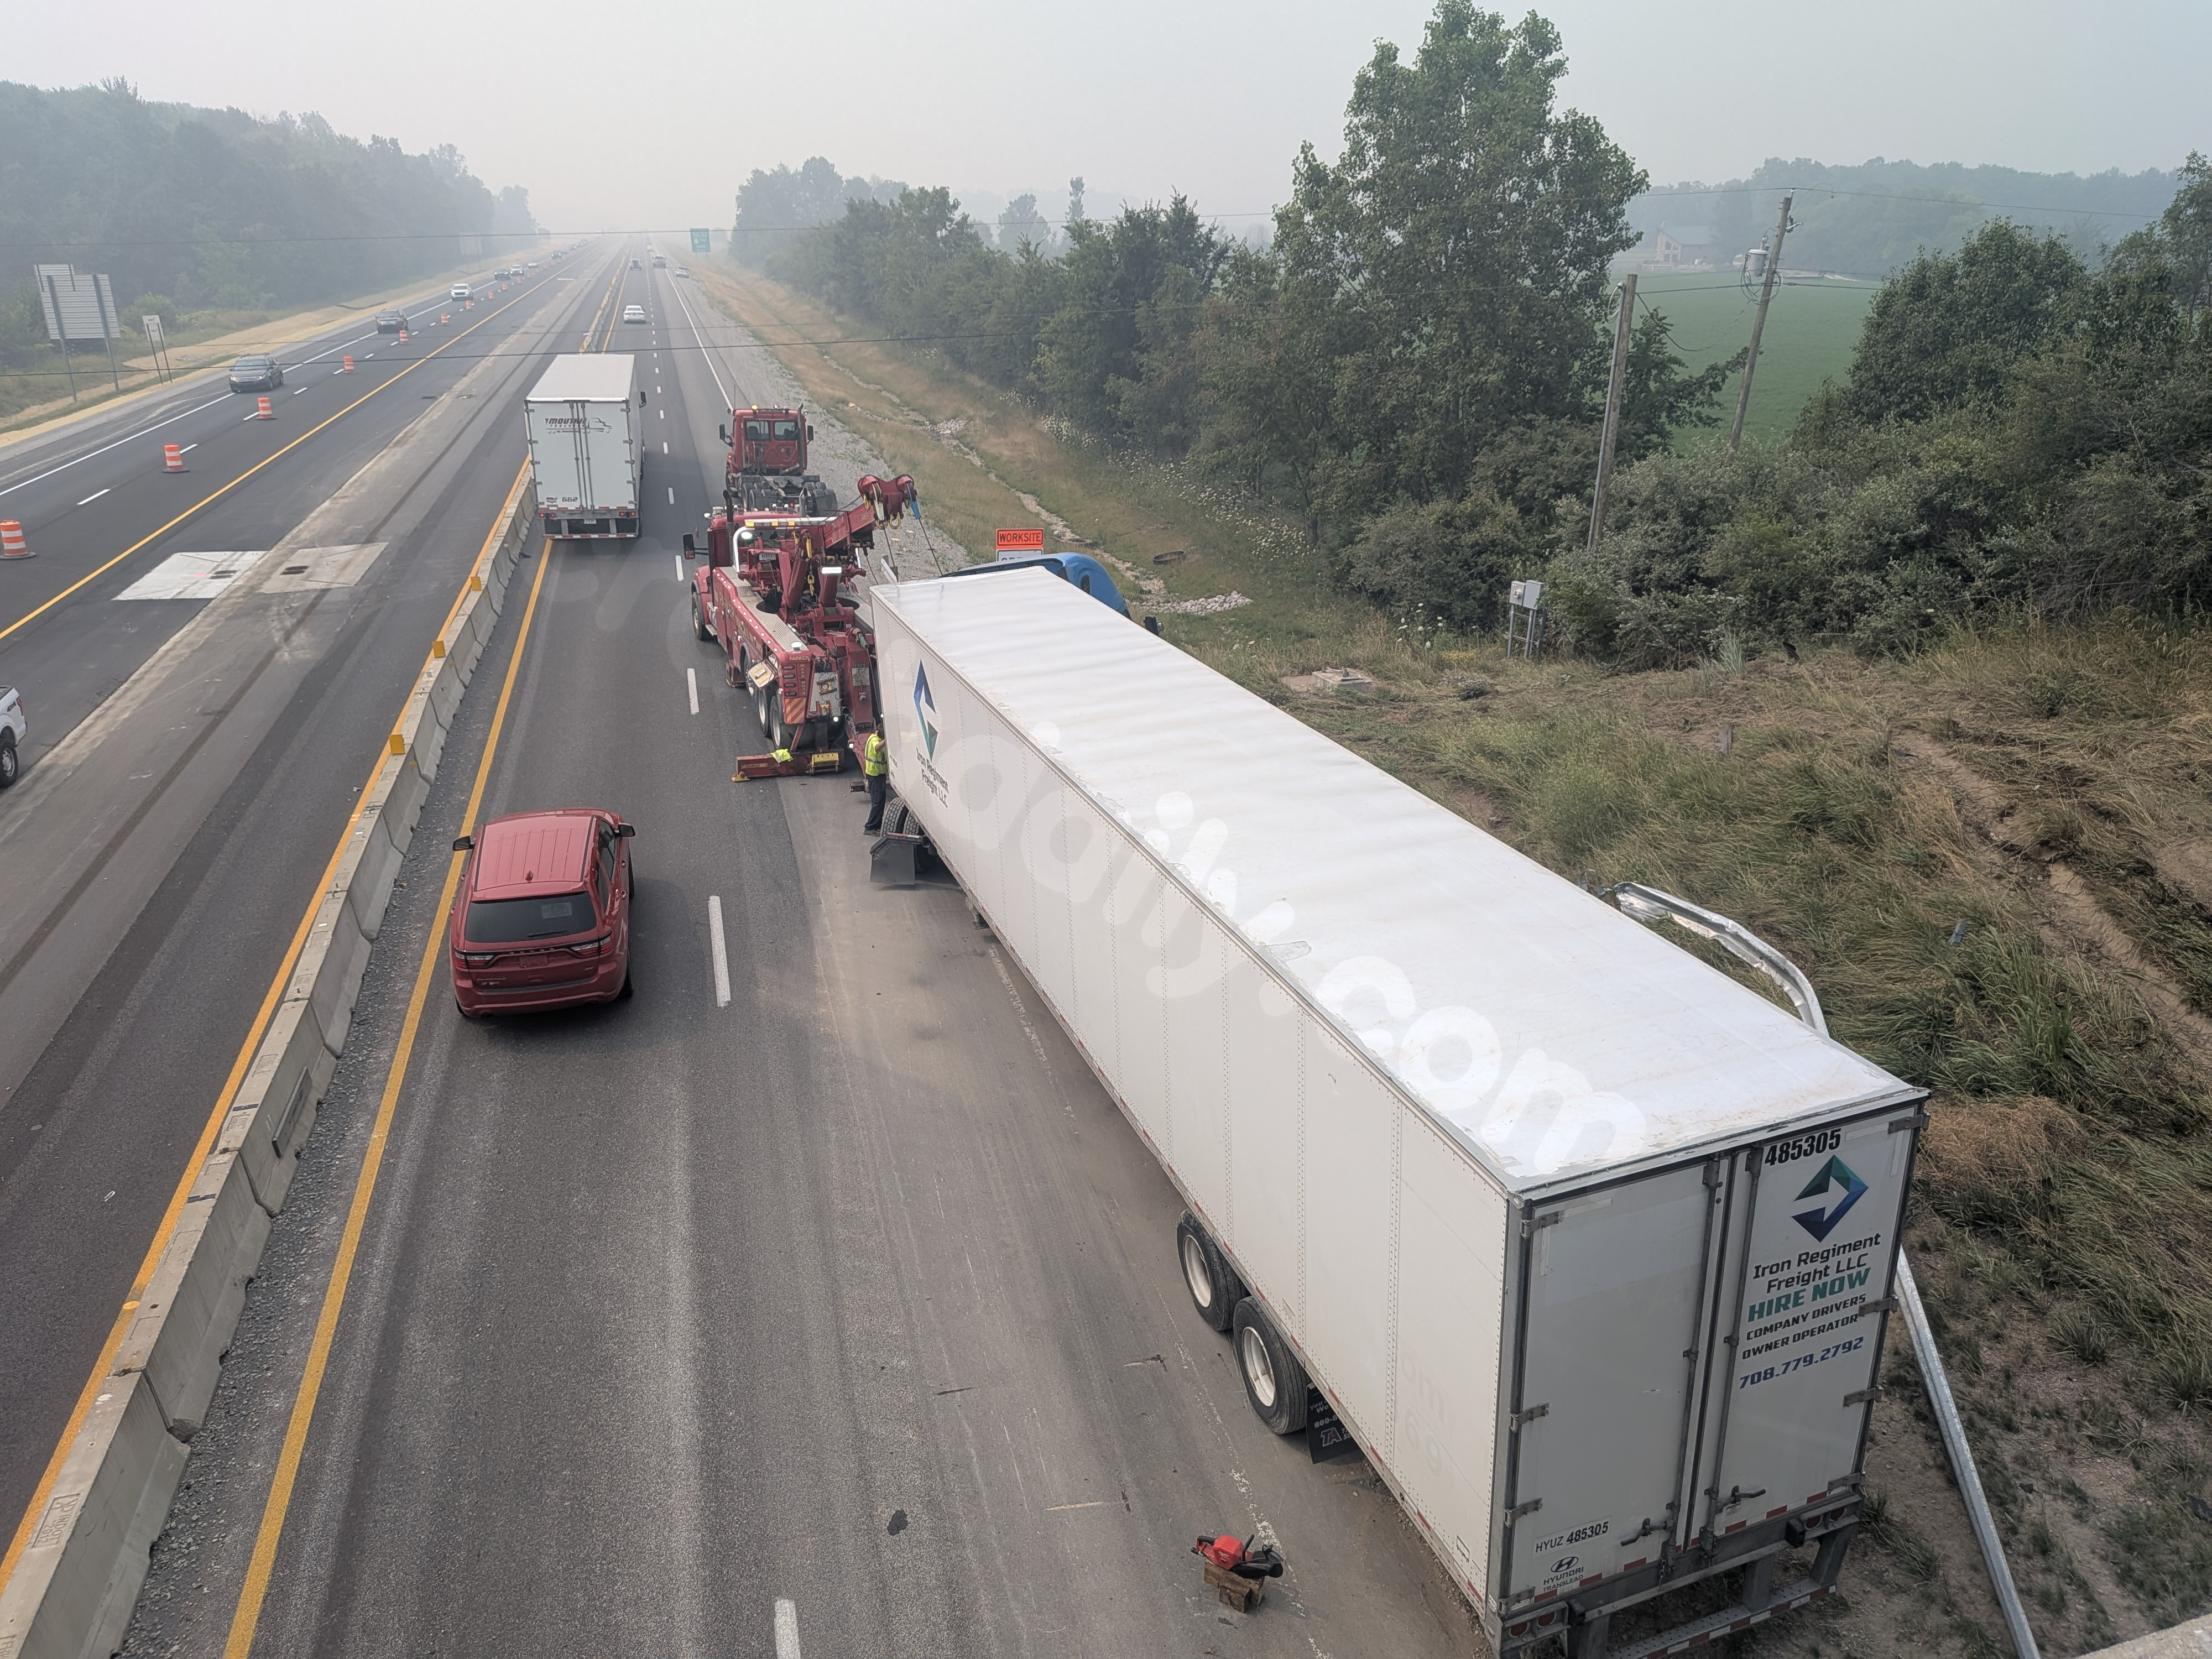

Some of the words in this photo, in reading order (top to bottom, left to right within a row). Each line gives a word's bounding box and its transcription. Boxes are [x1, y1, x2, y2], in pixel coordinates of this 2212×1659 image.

[999, 533, 1041, 542] WORKSITE
[916, 748, 926, 768] Iron
[926, 758, 949, 794] Regiment
[921, 768, 938, 797] Freight
[938, 788, 948, 808] LLC
[1764, 1128, 1841, 1166] 485305
[1752, 1259, 1792, 1280] Iron
[1796, 1233, 1881, 1267] Regiment
[1766, 1264, 1830, 1294] Freight
[1835, 1253, 1869, 1274] LLC
[1747, 1288, 1807, 1323] HIRE
[1811, 1266, 1871, 1302] NOW
[1742, 1336, 1790, 1360] OWNER
[1792, 1313, 1859, 1343] OPERATOR
[1746, 1311, 1810, 1341] COMPANY
[1811, 1293, 1866, 1319] DRIVERS
[1739, 1336, 1864, 1390] 708.779.2792
[1310, 1401, 1323, 1411] You
[1321, 1427, 1342, 1447] TA
[1535, 1535, 1564, 1553] HYUZ
[1566, 1521, 1609, 1544] 485305
[1542, 1574, 1584, 1592] TRANSLEAD
[1543, 1566, 1584, 1585] HYUNDAI
[1489, 1595, 1497, 1609] ABS
